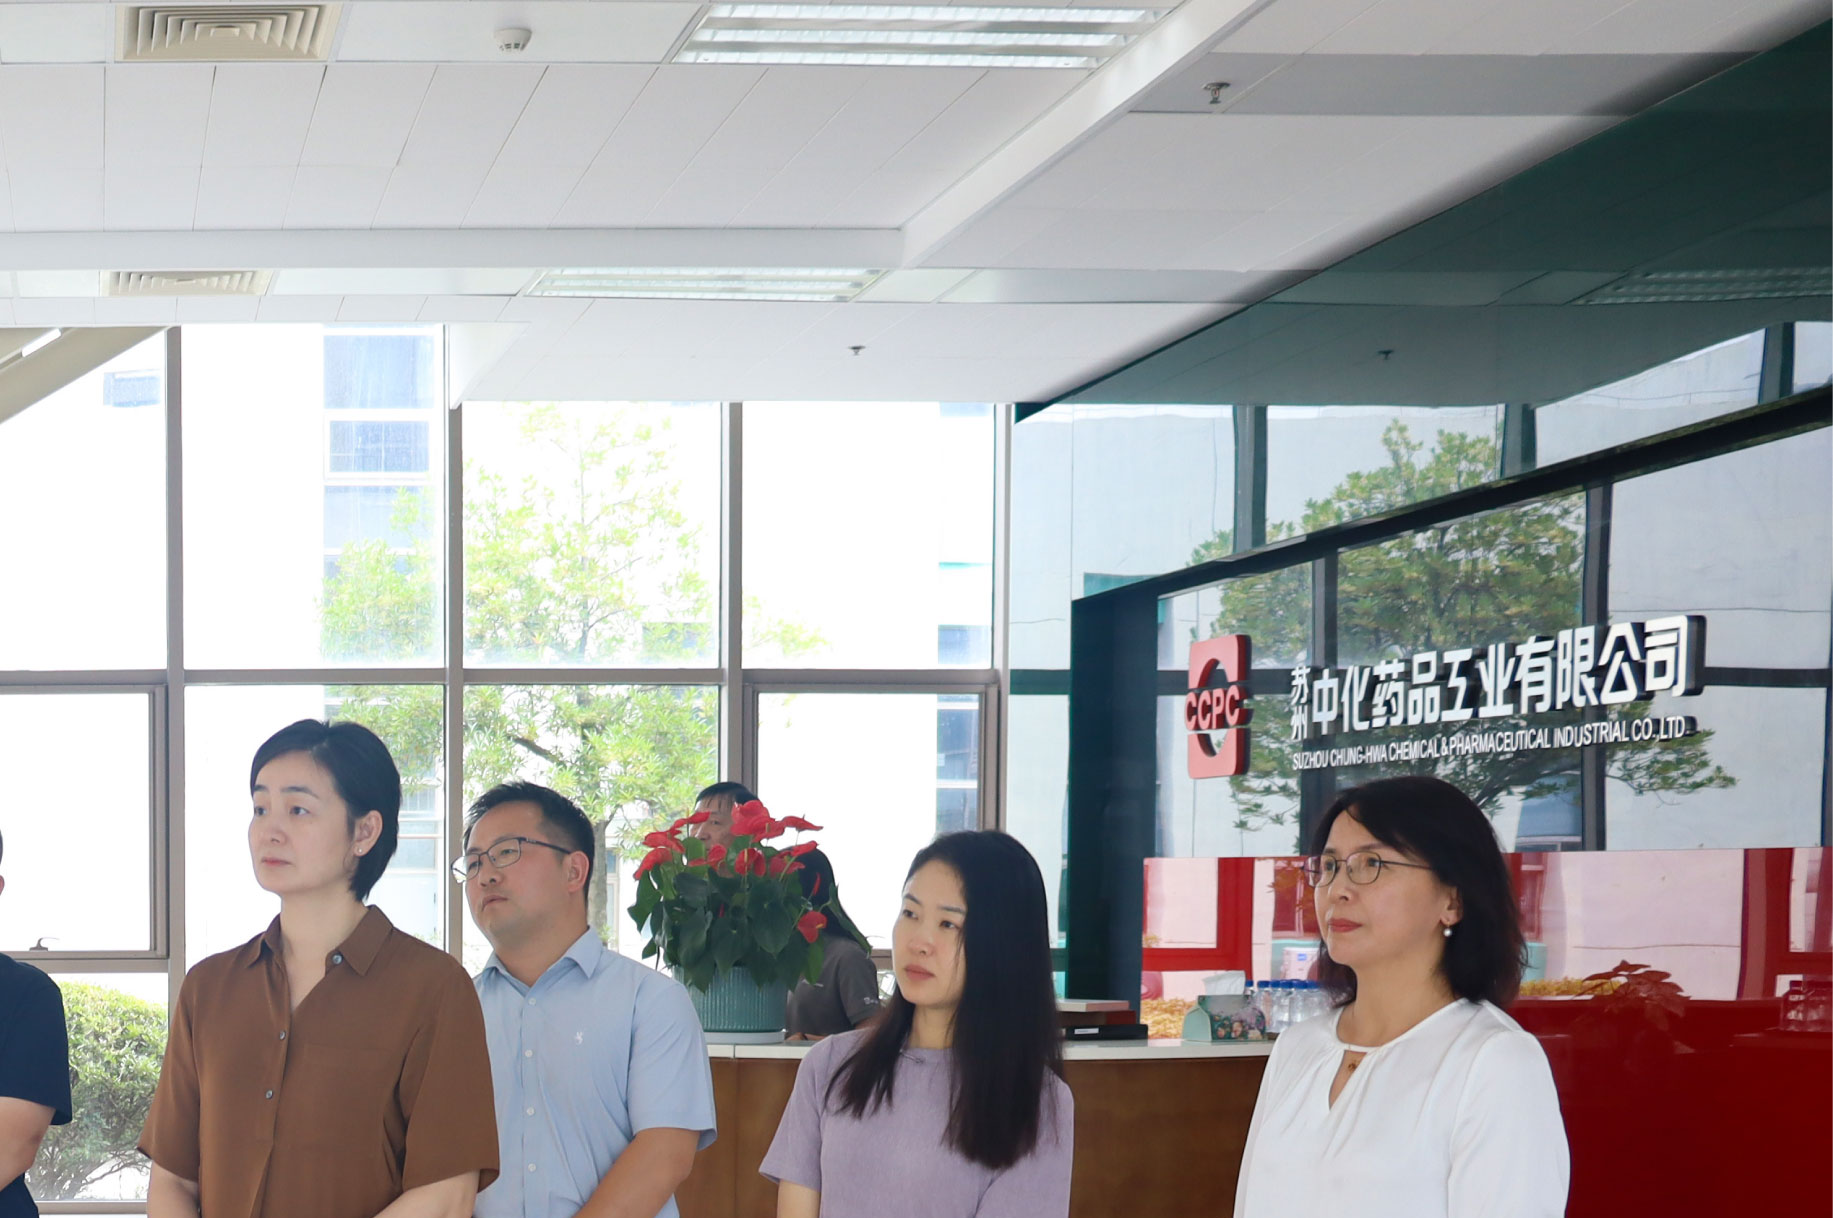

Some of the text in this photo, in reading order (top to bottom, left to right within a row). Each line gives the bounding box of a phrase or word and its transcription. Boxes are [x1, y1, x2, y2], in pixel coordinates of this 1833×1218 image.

[1290, 615, 1689, 741] 苏州中化药品工业有限公司
[1185, 685, 1241, 731] CCPC
[1292, 749, 1329, 770] SUZHOU
[1330, 744, 1388, 767] CHUNG-HWA
[1554, 719, 1630, 749] INDUSTRIAL
